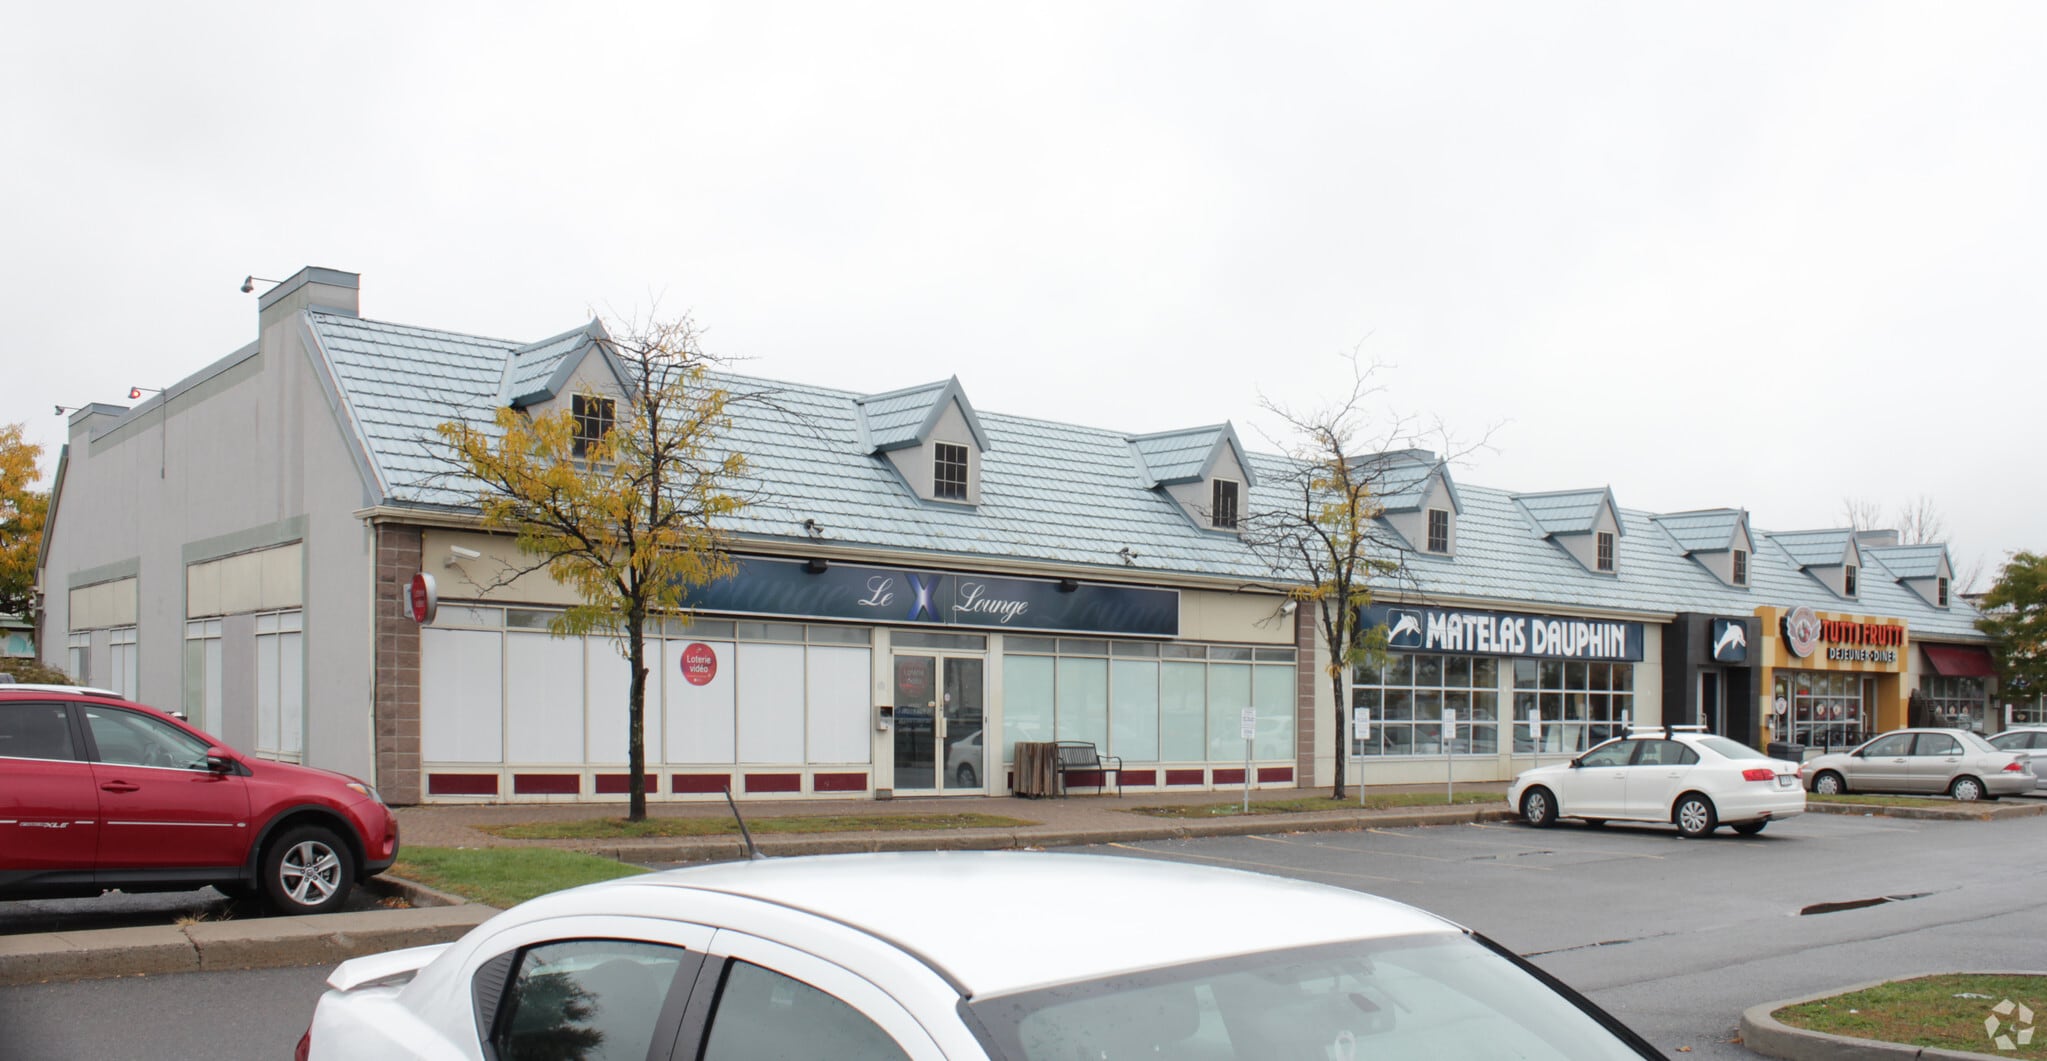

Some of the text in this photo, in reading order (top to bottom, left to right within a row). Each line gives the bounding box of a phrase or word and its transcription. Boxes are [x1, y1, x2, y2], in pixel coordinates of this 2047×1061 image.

[858, 576, 895, 607] Le
[952, 582, 1029, 624] Lounge
[1426, 612, 1626, 657] MATELAS DAUPHIN
[1822, 619, 1860, 643] TUTTI
[1863, 623, 1904, 646] FRUTTI
[687, 655, 712, 664] Loterie
